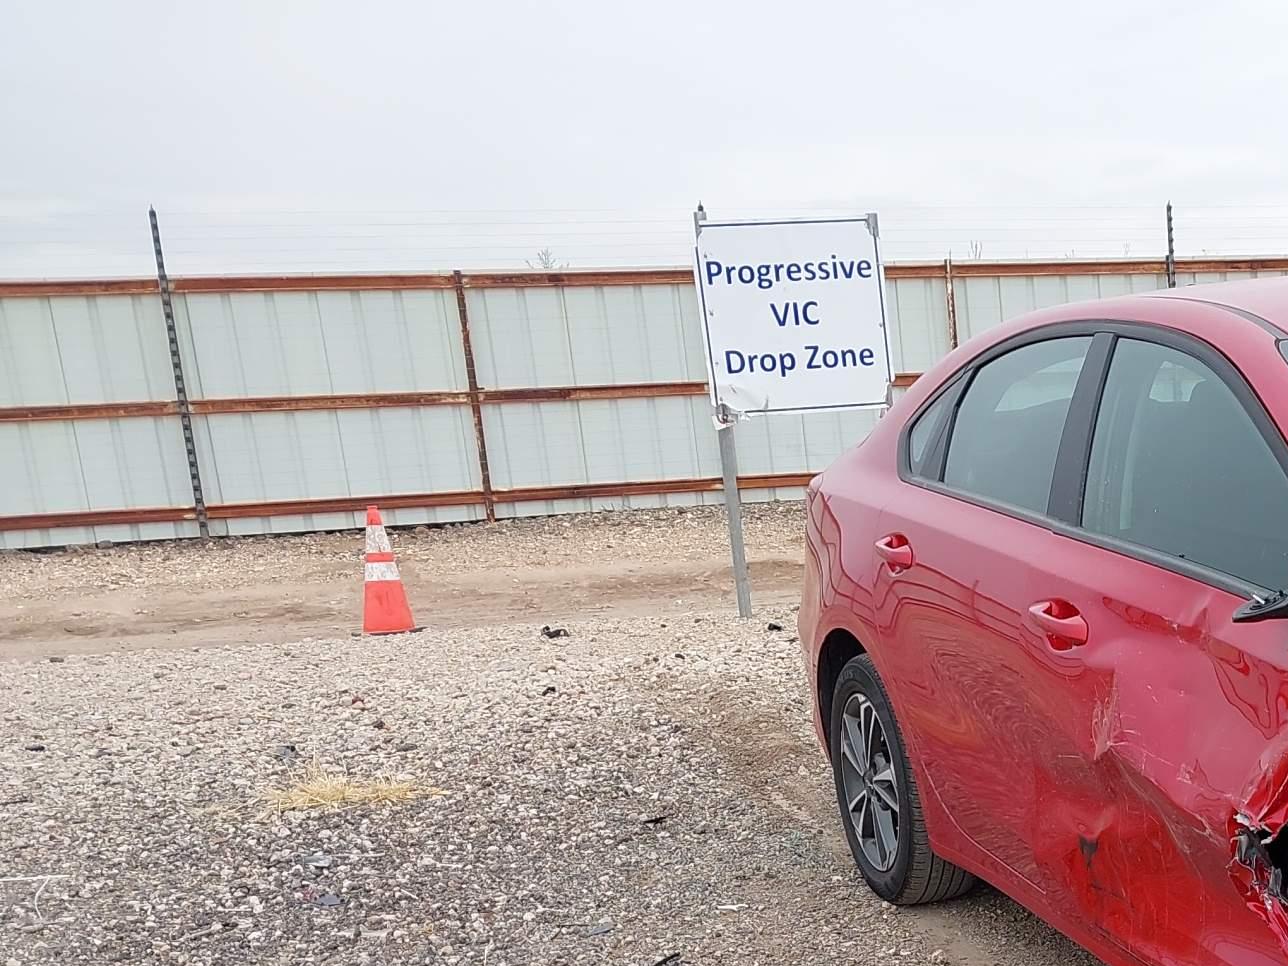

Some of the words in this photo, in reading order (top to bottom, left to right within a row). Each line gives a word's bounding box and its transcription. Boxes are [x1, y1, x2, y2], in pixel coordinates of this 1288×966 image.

[705, 255, 872, 290] Progressive
[769, 300, 820, 327] VIC
[724, 348, 796, 377] Drop
[804, 345, 875, 370] Zone
